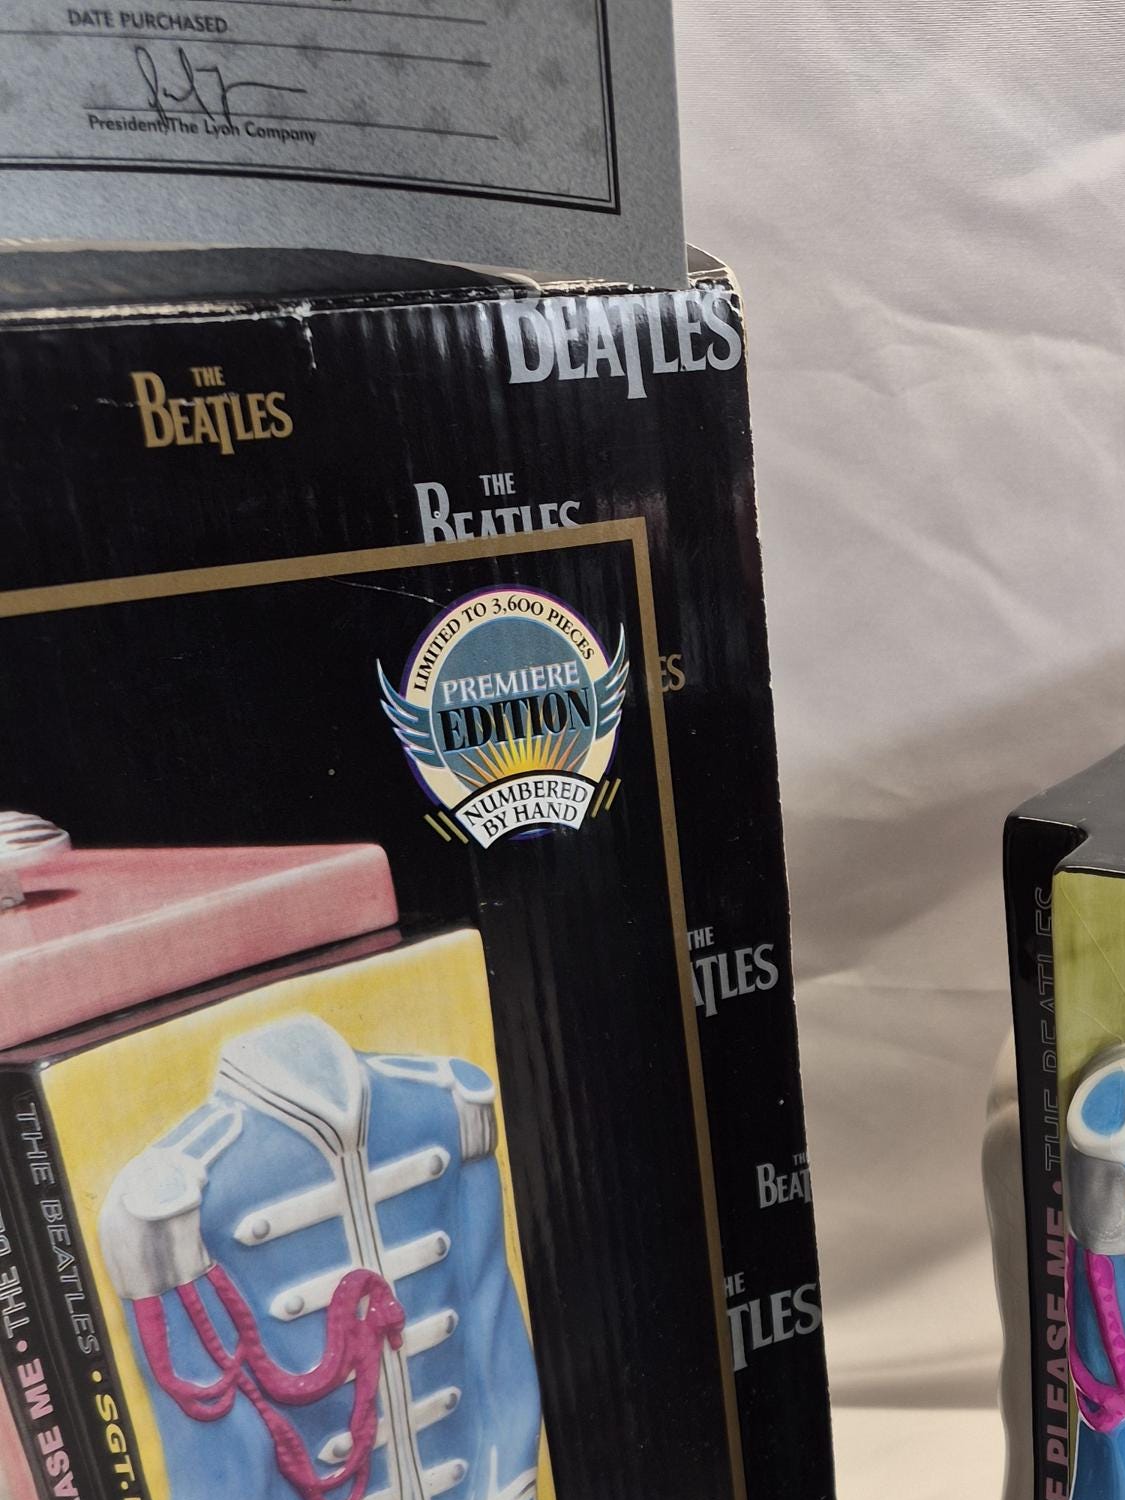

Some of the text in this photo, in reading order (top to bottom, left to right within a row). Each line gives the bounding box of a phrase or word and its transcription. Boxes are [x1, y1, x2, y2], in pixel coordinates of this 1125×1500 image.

[67, 8, 228, 33] DATE PURCHASED
[169, 118, 198, 134] The
[204, 119, 240, 140] Lyon
[245, 122, 317, 145] Company
[500, 291, 742, 399] BEATLES
[189, 366, 226, 387] THE
[130, 371, 293, 455] BEATLES
[479, 473, 516, 496] THE
[413, 594, 596, 692] LIMITED TO 3,600 PIECES
[440, 659, 581, 705] PREMIERE
[437, 688, 591, 752] EDITION
[463, 780, 588, 827] NUMBERED
[482, 802, 578, 839] BY HAND
[756, 1163, 812, 1209] BEAT
[16, 1102, 55, 1185] THE
[40, 1199, 100, 1354] BEATLES
[0, 1265, 30, 1339] THE
[17, 1357, 55, 1421] ME
